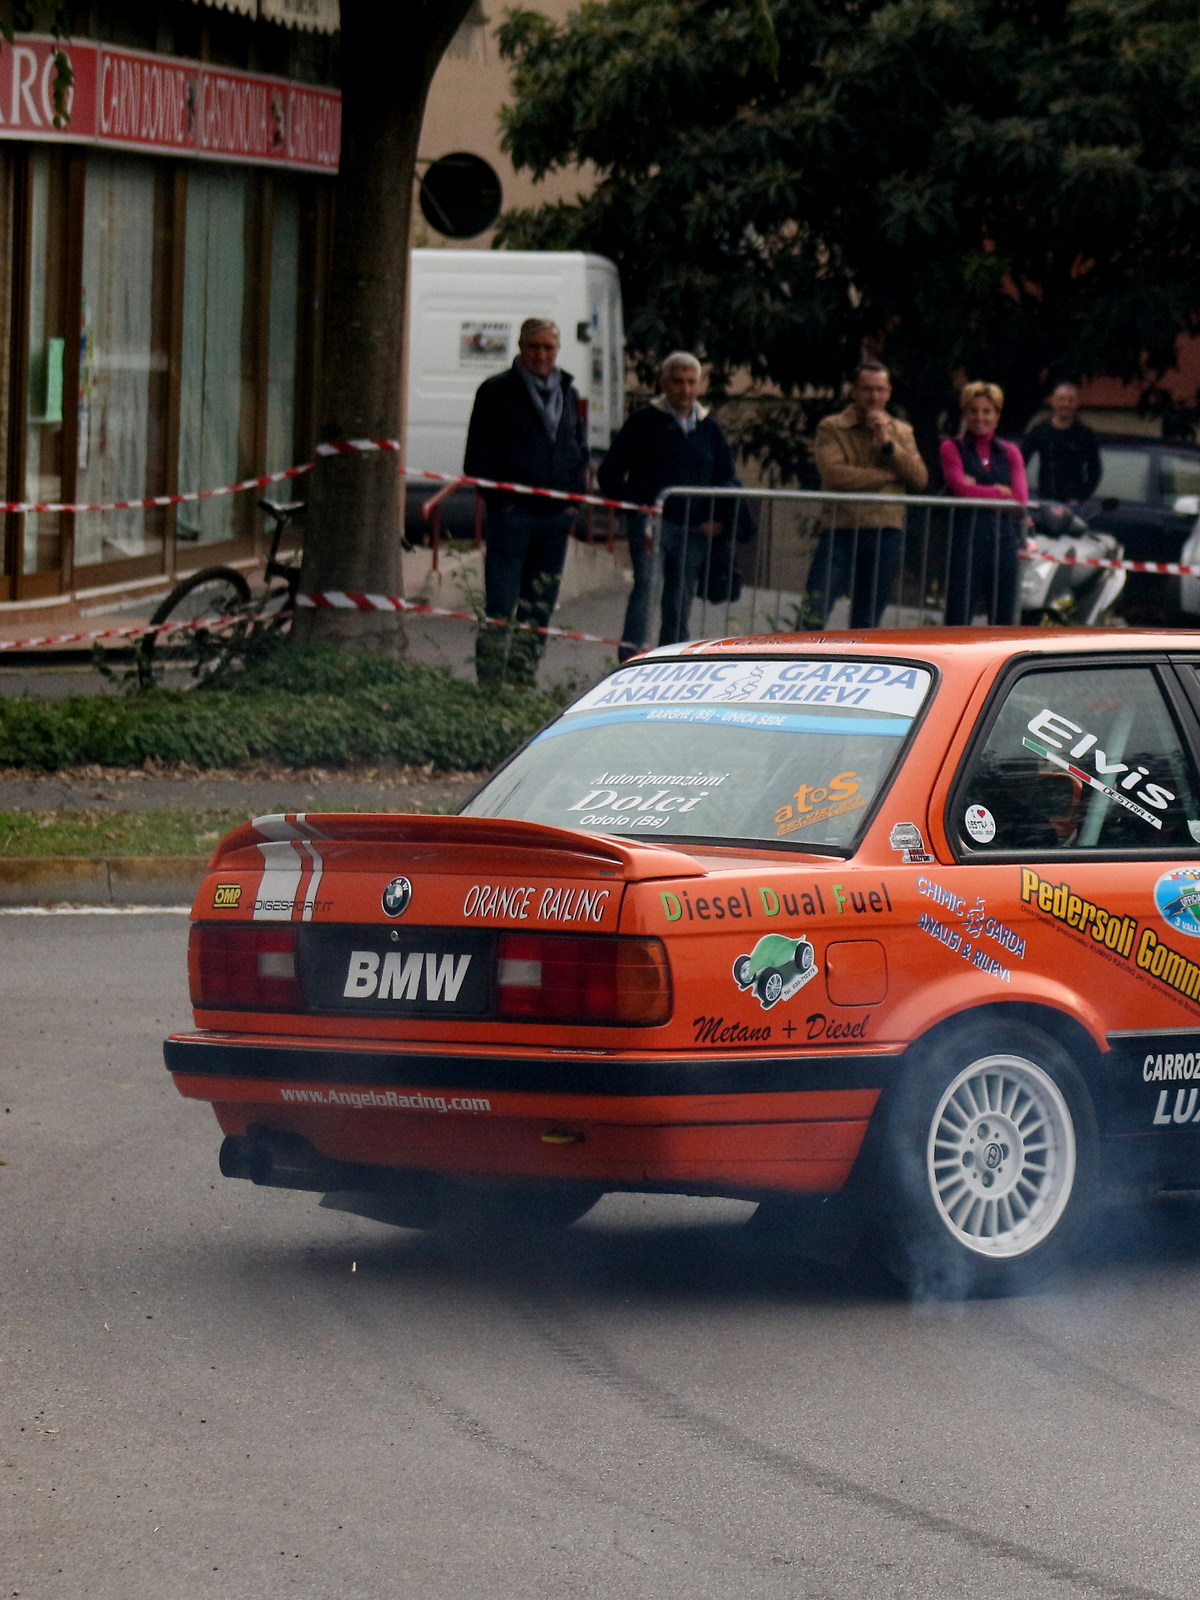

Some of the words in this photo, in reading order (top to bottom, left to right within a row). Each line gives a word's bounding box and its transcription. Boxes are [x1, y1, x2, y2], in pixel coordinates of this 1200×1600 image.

[0, 46, 75, 127] RO
[610, 663, 739, 686] CHIMIC
[777, 663, 918, 690] GARDA
[592, 683, 714, 705] ANALISI
[758, 683, 872, 705] RILIEVI
[646, 709, 693, 720] BARGHE
[720, 711, 758, 724] UNICA
[757, 715, 788, 726] SEDE
[1027, 708, 1177, 811] Elvis
[590, 771, 730, 788] Autoriparazioni
[566, 789, 709, 813] Dolci
[1101, 786, 1144, 817] DESTRA
[1146, 813, 1157, 825] 4
[579, 814, 630, 826] Odolo
[630, 815, 670, 829] (Bs)
[214, 887, 242, 905] OMP
[246, 899, 334, 913] ADIGESPORT.IT
[462, 884, 536, 920] ORANGE
[536, 886, 611, 924] RAILING
[660, 887, 753, 922] Diesel
[758, 884, 826, 917] Dual
[832, 882, 893, 914] Fuel
[917, 876, 967, 917] CHIMIC
[984, 915, 1027, 960] GARDA
[1020, 866, 1139, 961] Pedersoli
[1174, 917, 1181, 927] 3
[1182, 921, 1200, 933] VALLI
[917, 912, 964, 953] ANALISI
[961, 941, 972, 961] &
[972, 949, 1012, 983] RILIEVI
[343, 950, 472, 1002] BMW
[692, 1015, 772, 1044] Metano
[782, 1019, 798, 1039] +
[806, 1012, 871, 1041] Diesel
[280, 1087, 493, 1114] www.AngeloRacing.com
